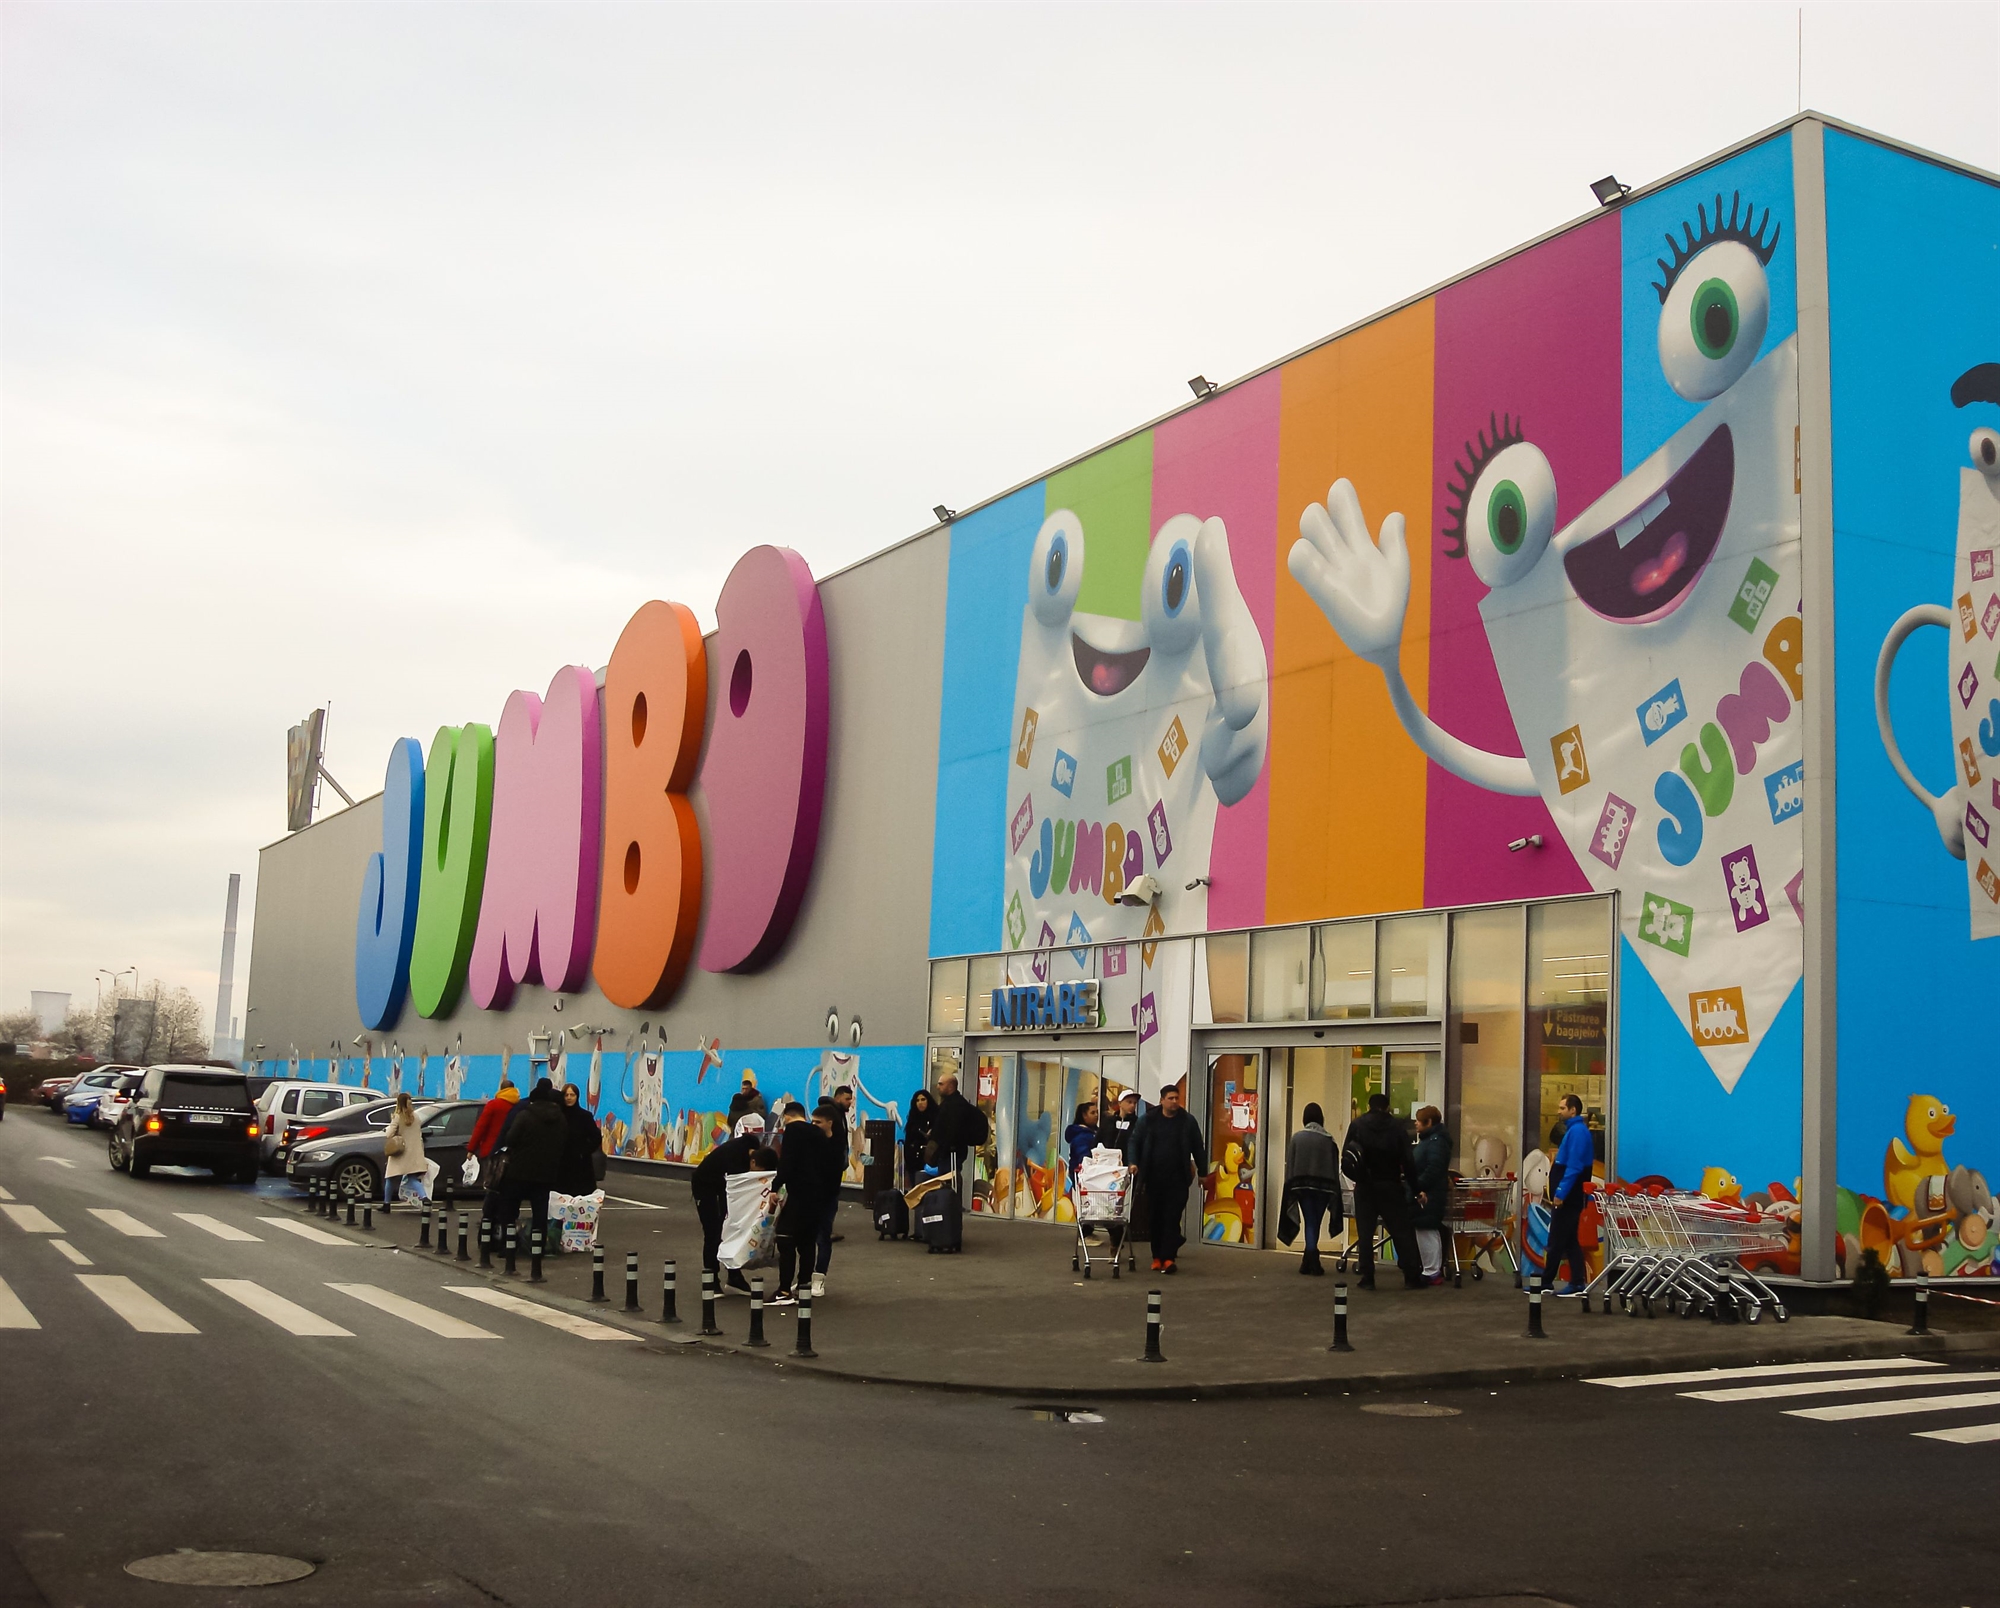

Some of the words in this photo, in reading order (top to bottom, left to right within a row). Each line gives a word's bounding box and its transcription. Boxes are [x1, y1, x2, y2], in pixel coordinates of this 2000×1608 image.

[356, 544, 827, 1030] JUMBO
[1030, 817, 1143, 906] JUMBO
[990, 981, 1091, 1027] INTRARE
[1556, 1024, 1599, 1040] bagajelor
